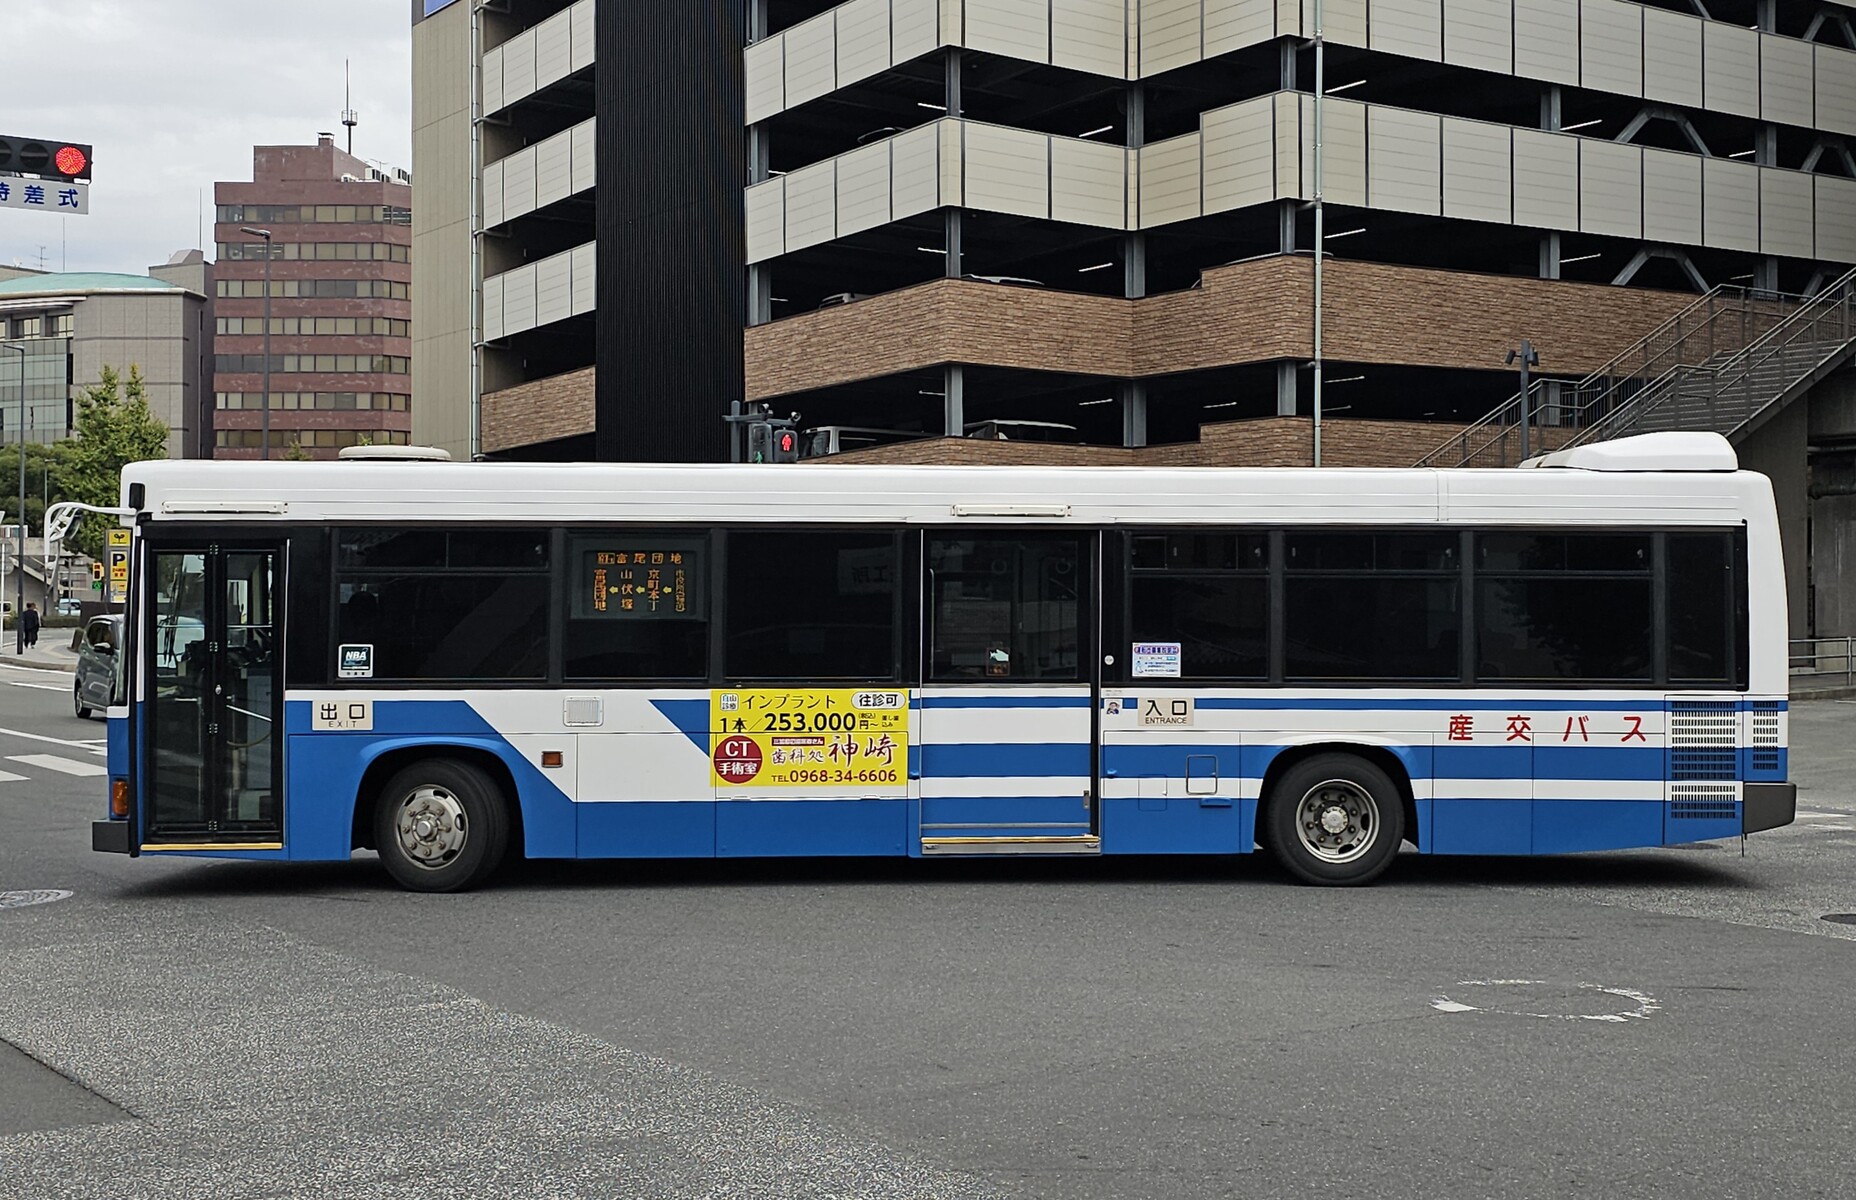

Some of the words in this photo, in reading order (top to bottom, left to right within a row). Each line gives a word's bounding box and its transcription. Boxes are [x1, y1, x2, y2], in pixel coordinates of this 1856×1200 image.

[112, 553, 126, 567] P
[345, 651, 367, 661] NBA
[742, 693, 836, 710] インプラント
[859, 693, 898, 707] 往診可
[321, 703, 365, 720] 出口
[1145, 700, 1187, 716] 入口
[1145, 717, 1187, 725] ENTRANCE
[1448, 714, 1647, 742] 産交バス
[725, 740, 752, 757] CT
[718, 762, 757, 775] 手術室
[790, 769, 897, 782] 0968-34-6606
